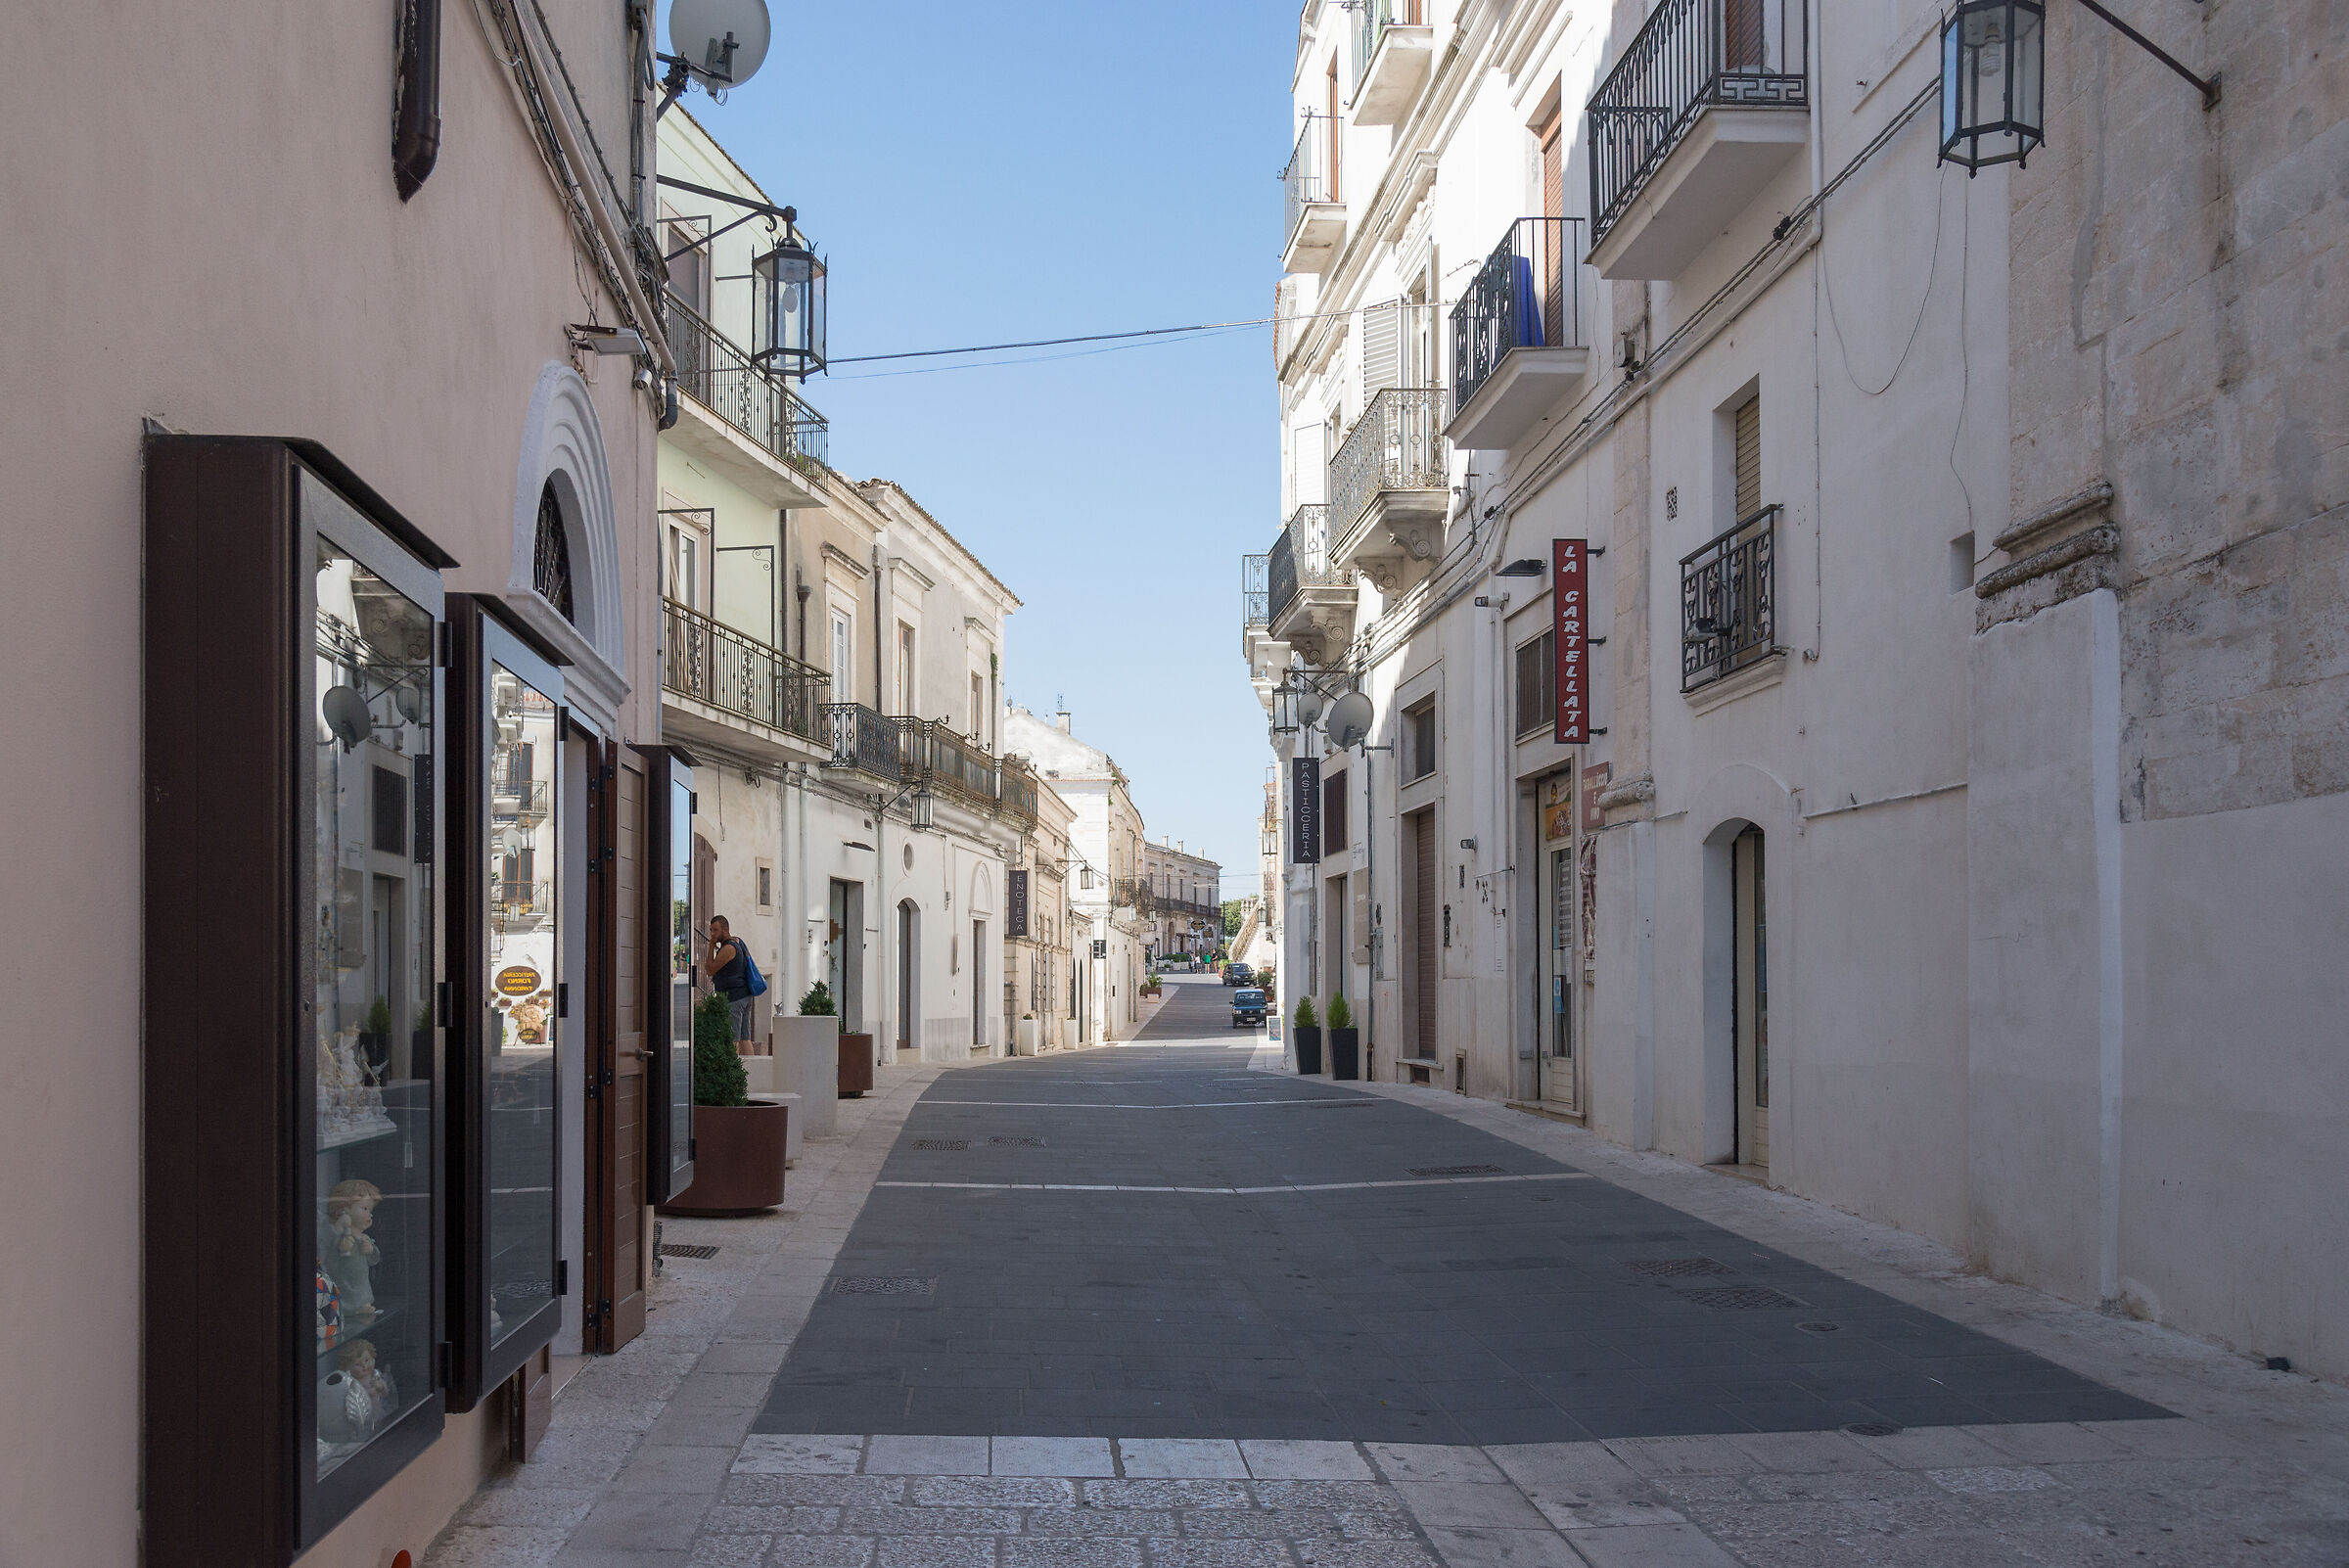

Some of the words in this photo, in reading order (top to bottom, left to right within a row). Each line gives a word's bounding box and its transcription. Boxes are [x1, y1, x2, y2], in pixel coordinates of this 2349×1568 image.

[1562, 545, 1577, 573] LA
[1562, 590, 1582, 738] CARTELLATA
[1300, 762, 1312, 857] PASTICCERIA
[1015, 875, 1025, 931] ENOTECA
